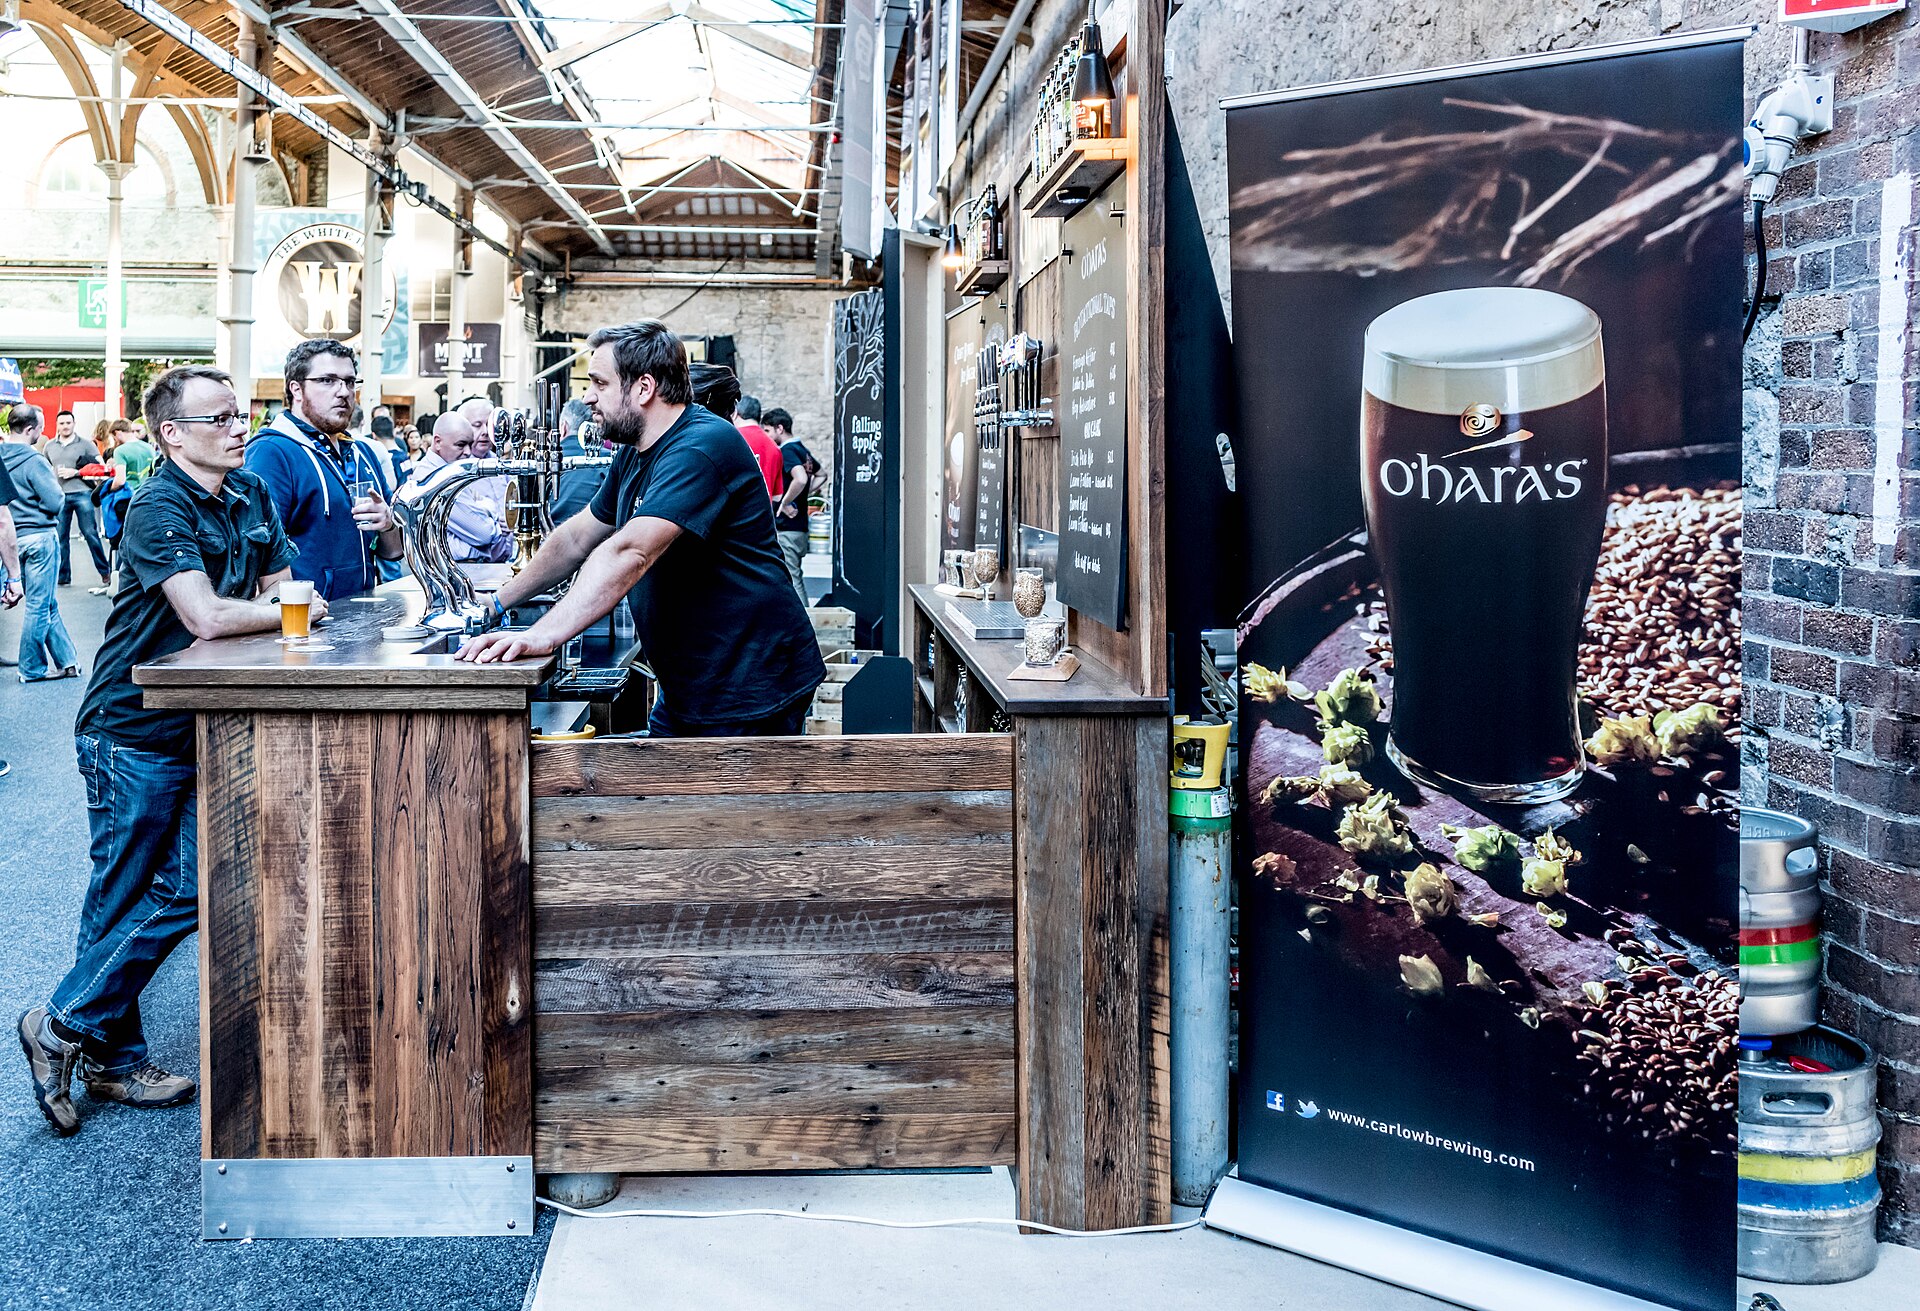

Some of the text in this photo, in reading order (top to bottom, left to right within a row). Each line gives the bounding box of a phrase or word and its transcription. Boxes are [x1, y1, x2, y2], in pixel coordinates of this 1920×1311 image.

[275, 236, 301, 259] THE
[303, 227, 353, 241] WHITE
[434, 342, 485, 359] MNT
[852, 415, 882, 441] falling
[852, 433, 878, 454] apple
[1327, 1108, 1535, 1171] www.carlowbrewing.com
